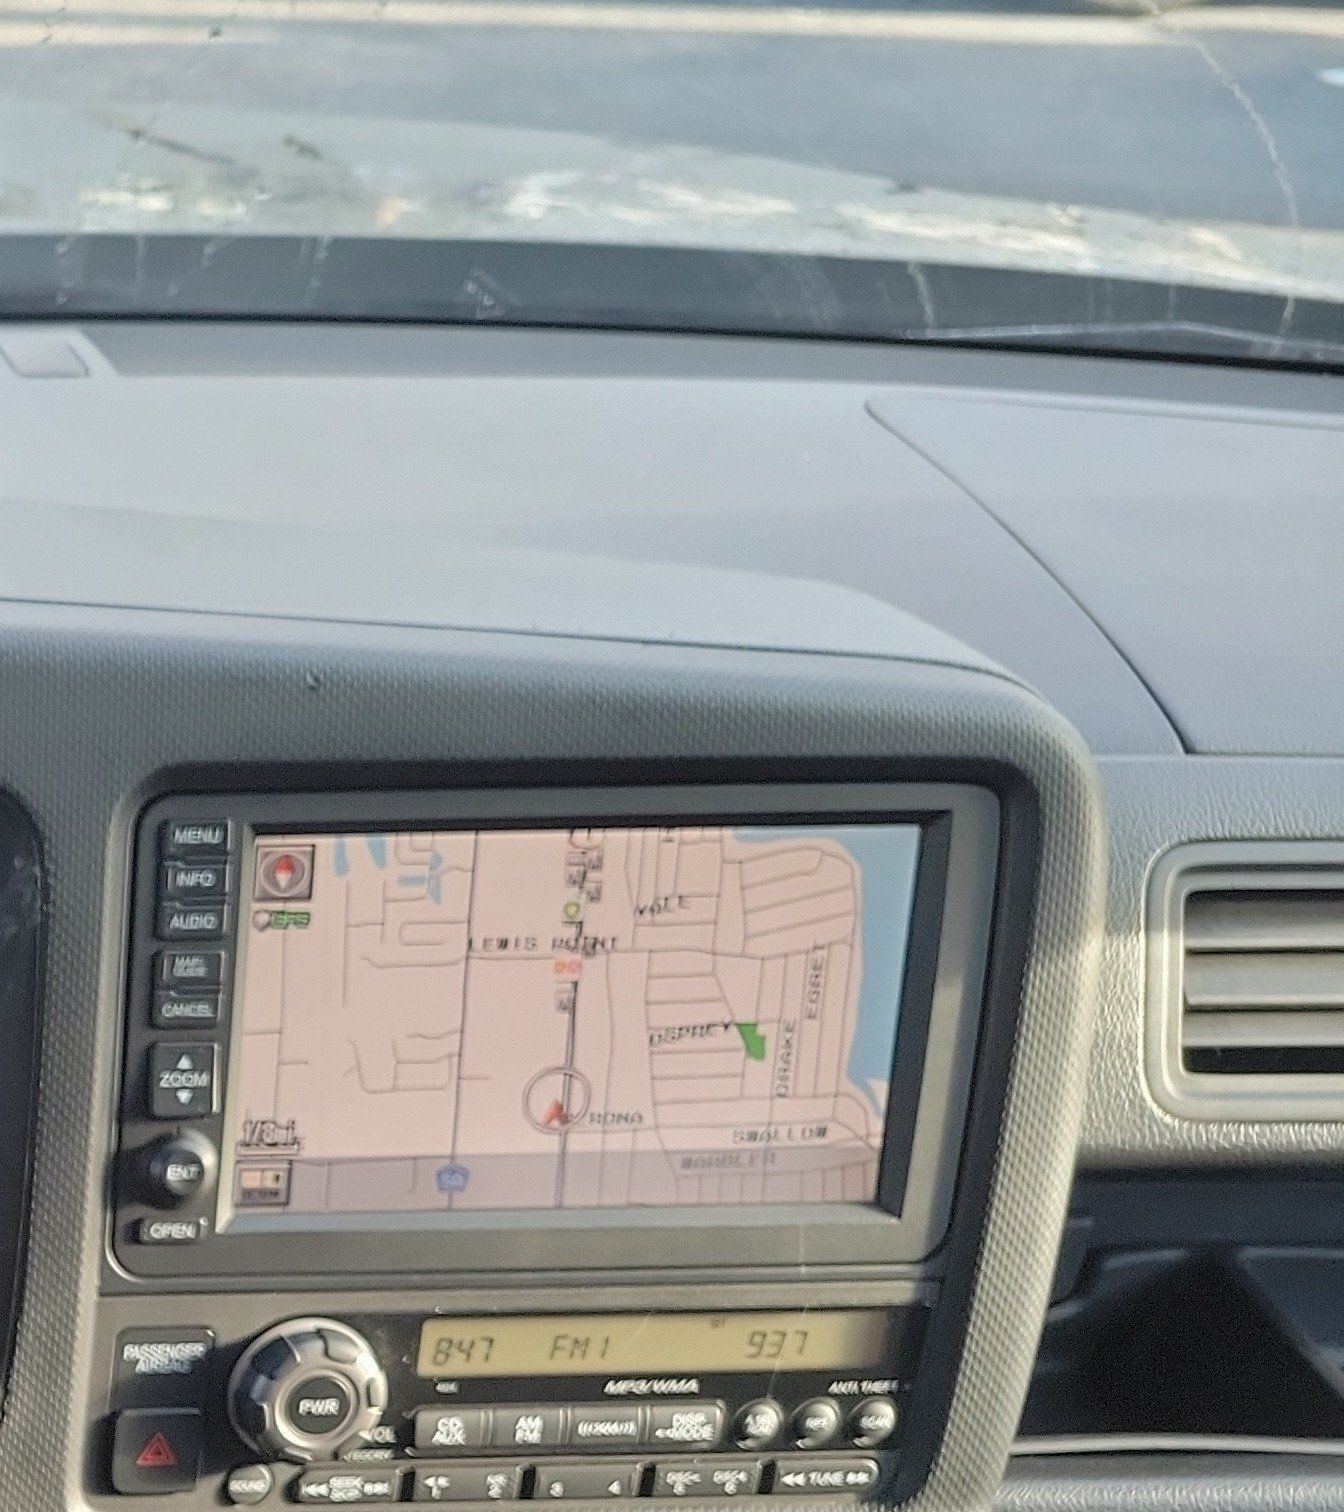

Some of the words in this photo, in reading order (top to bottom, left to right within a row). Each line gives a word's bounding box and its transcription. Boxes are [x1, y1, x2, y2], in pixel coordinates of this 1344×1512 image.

[174, 826, 224, 844] MENU
[176, 869, 217, 888] INFO
[170, 912, 219, 931] AUDIO
[162, 1001, 215, 1018] CANCEL
[649, 1020, 732, 1048] OSPREY
[159, 1069, 210, 1088] ZOOM
[150, 1222, 197, 1240] OPEN
[123, 1342, 207, 1360] PASSENGER
[298, 1397, 341, 1416] PWR
